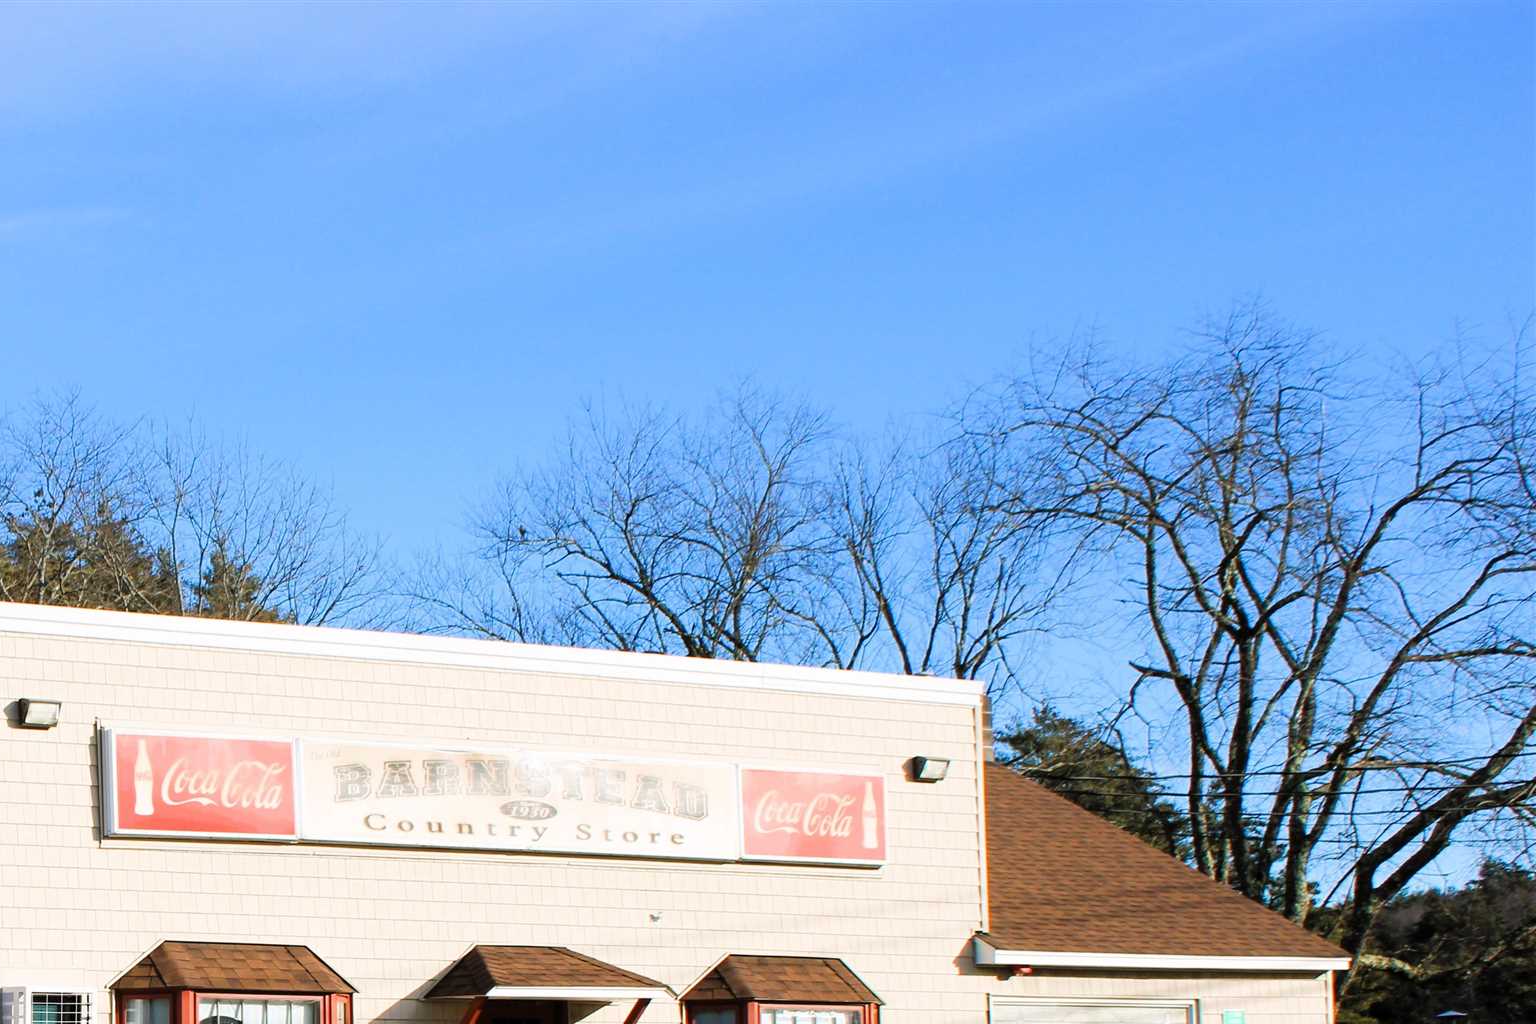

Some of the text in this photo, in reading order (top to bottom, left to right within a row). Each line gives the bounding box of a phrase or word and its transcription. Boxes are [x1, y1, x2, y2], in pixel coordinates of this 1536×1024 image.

[333, 759, 709, 822] BARNSTEAD
[364, 812, 686, 846] Country Store
